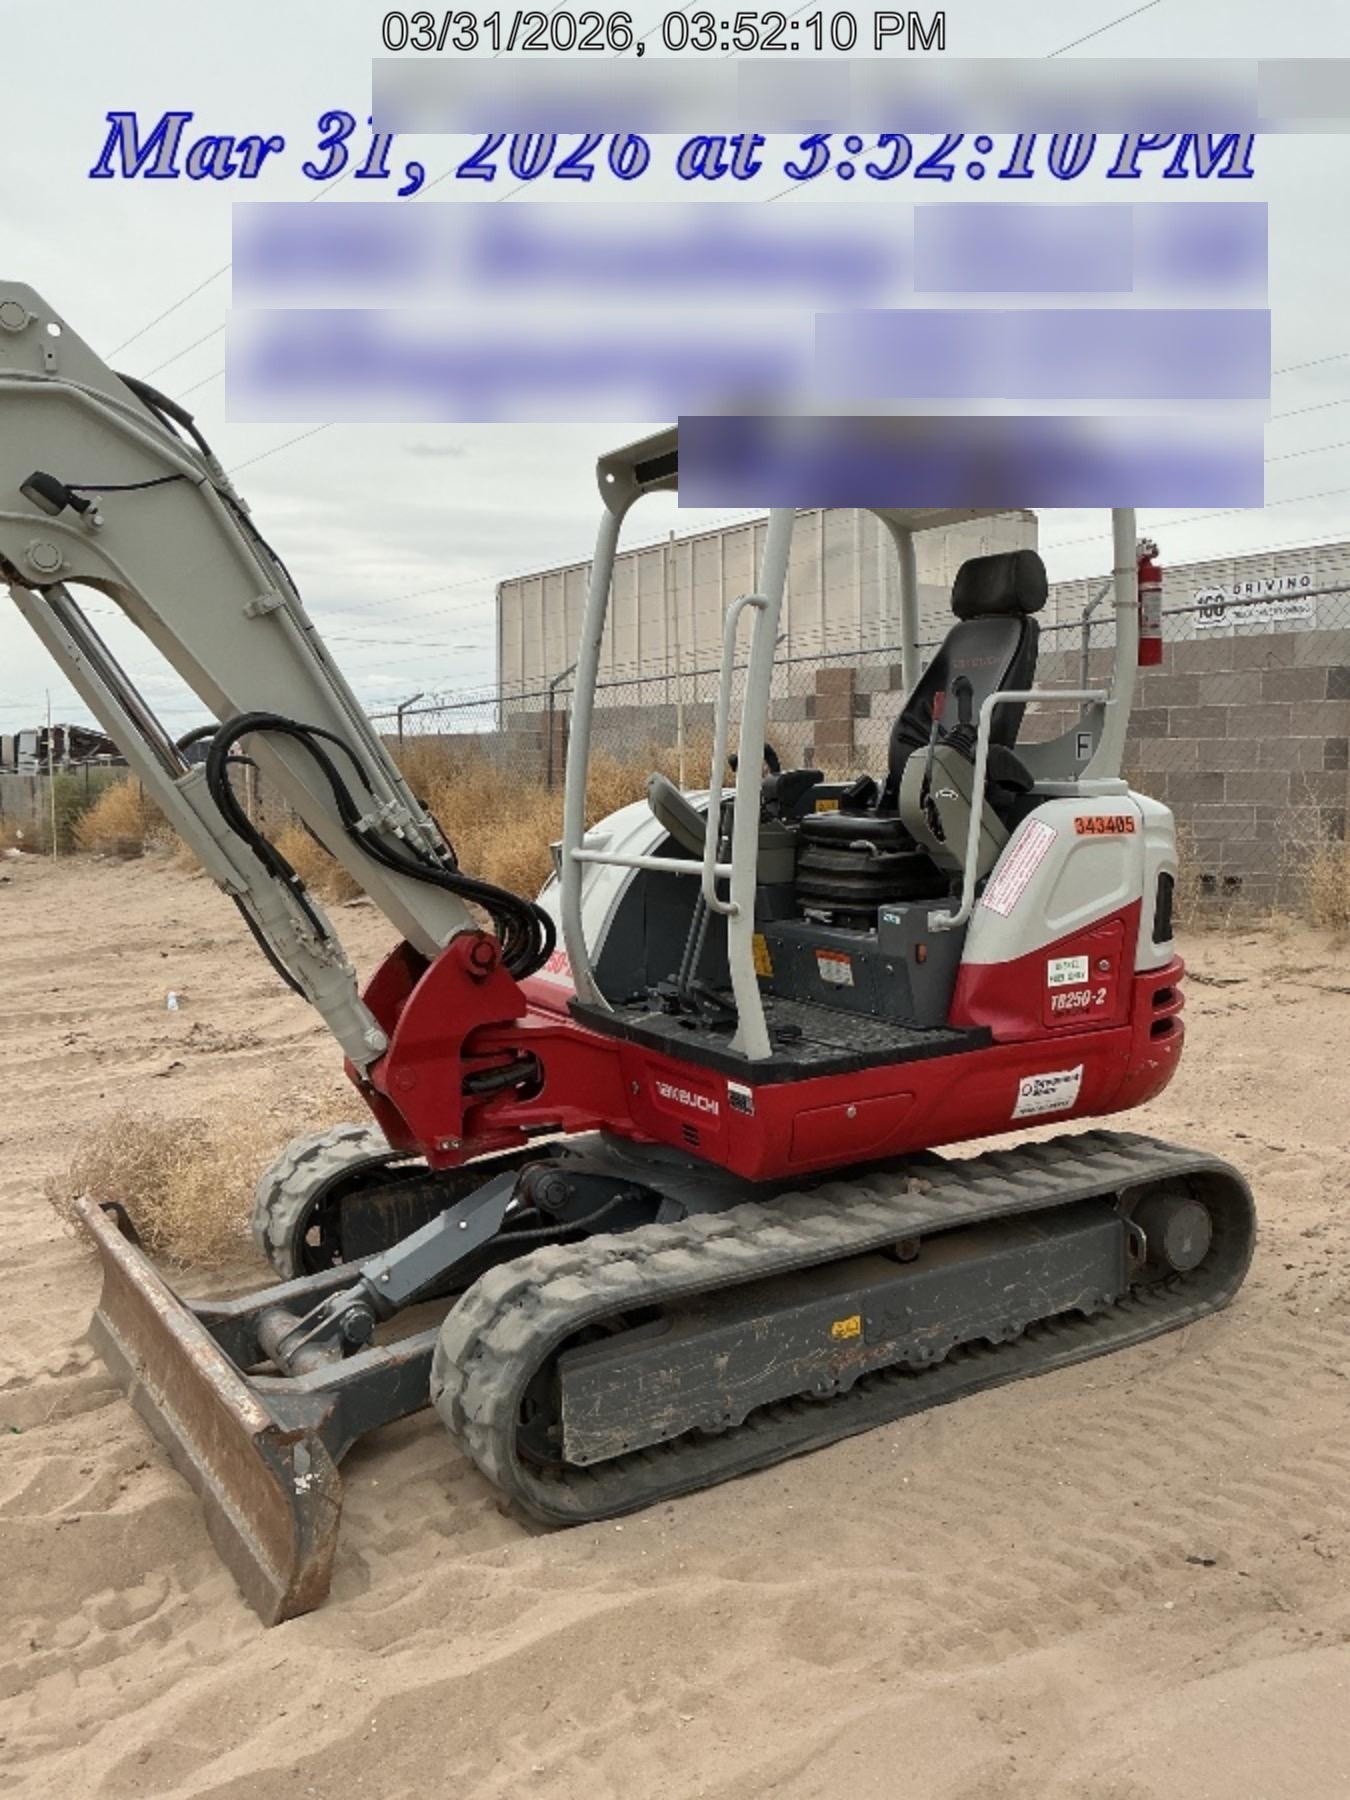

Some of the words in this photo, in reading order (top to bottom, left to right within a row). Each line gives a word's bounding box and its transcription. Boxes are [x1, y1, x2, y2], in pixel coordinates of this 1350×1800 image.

[1077, 734, 1091, 758] F
[1073, 816, 1135, 835] 343405
[1051, 987, 1107, 1011] TB250-2
